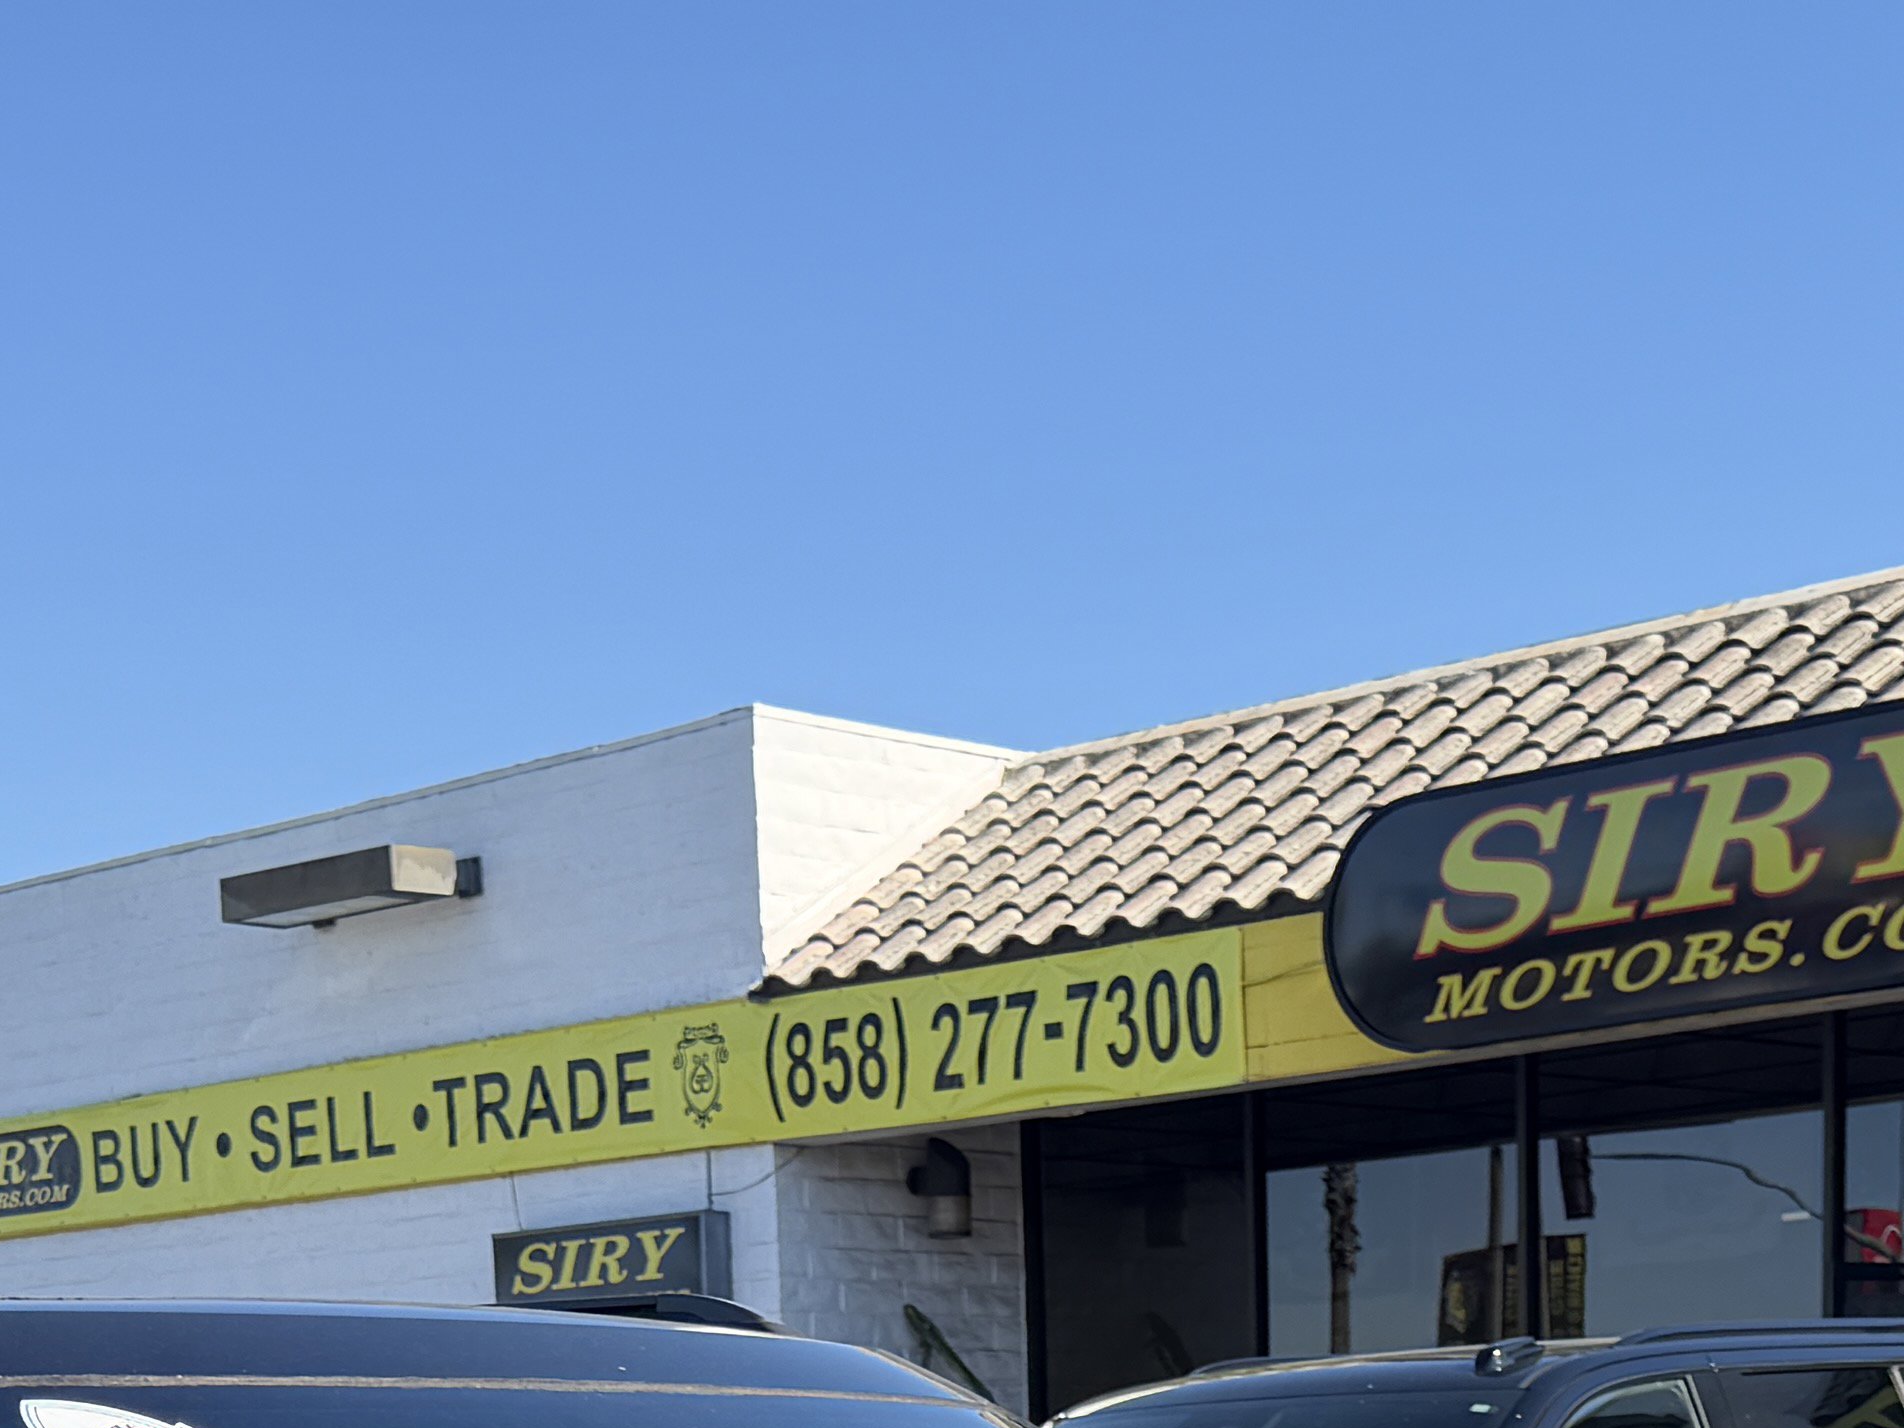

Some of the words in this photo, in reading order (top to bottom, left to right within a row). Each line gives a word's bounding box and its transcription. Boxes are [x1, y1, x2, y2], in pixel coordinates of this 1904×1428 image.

[765, 997, 908, 1122] (858)
[931, 962, 1223, 1092] 277-7300
[92, 1116, 198, 1193] BUY
[249, 1091, 395, 1174] SELL
[432, 1050, 656, 1148] TRADE
[512, 1227, 686, 1296] SIRY
